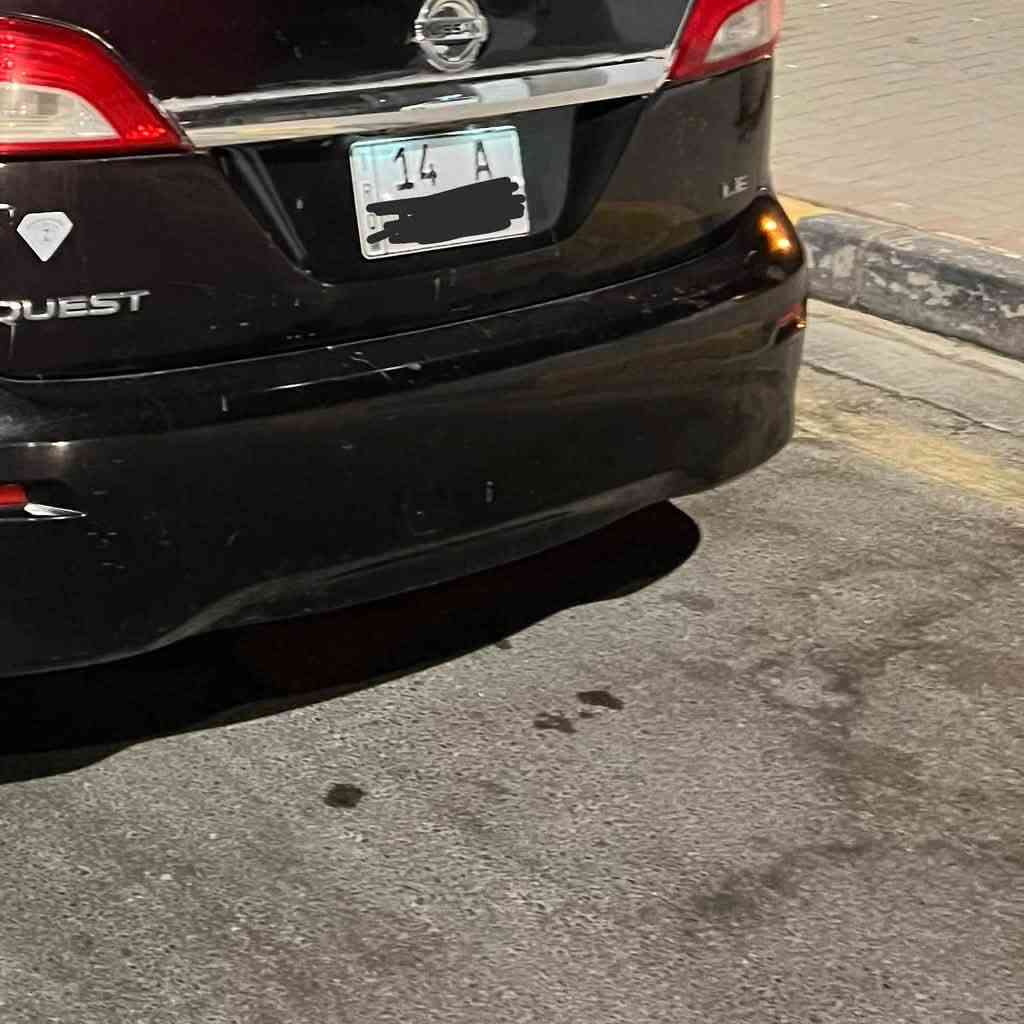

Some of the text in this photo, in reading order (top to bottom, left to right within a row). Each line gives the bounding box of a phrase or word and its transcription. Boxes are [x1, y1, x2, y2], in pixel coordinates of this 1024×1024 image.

[393, 143, 438, 191] 14
[475, 139, 493, 180] A
[722, 176, 750, 198] LE
